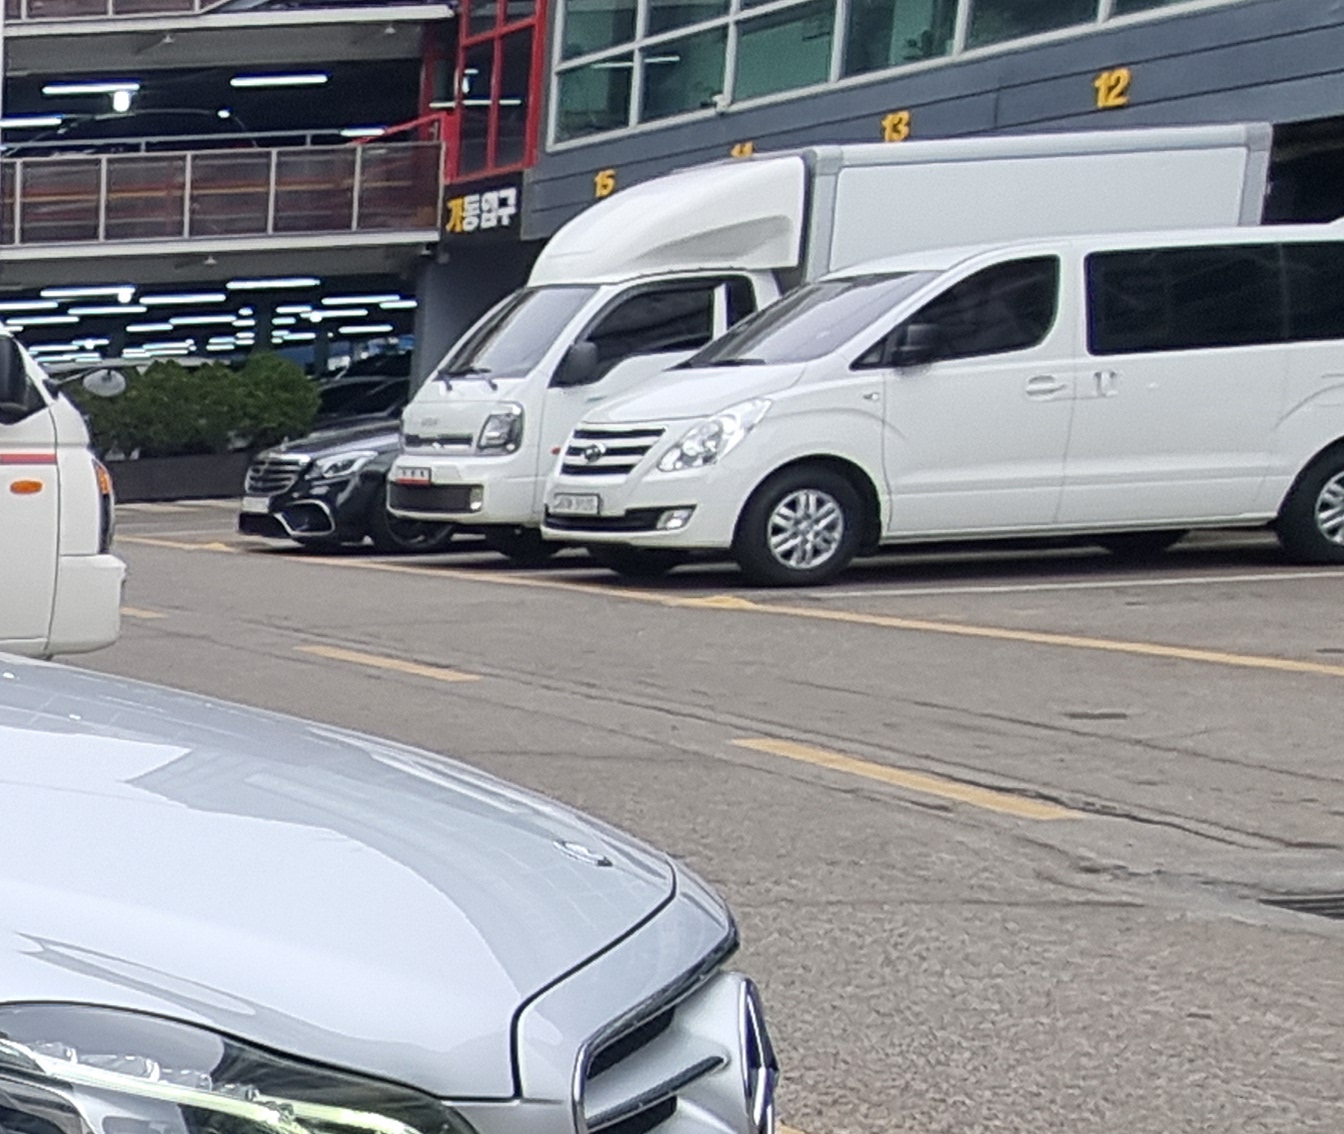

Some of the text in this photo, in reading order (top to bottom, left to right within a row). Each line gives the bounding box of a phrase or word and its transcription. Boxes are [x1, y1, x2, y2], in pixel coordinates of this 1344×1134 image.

[1093, 68, 1132, 108] 12
[881, 110, 910, 142] 13
[594, 169, 616, 198] 15
